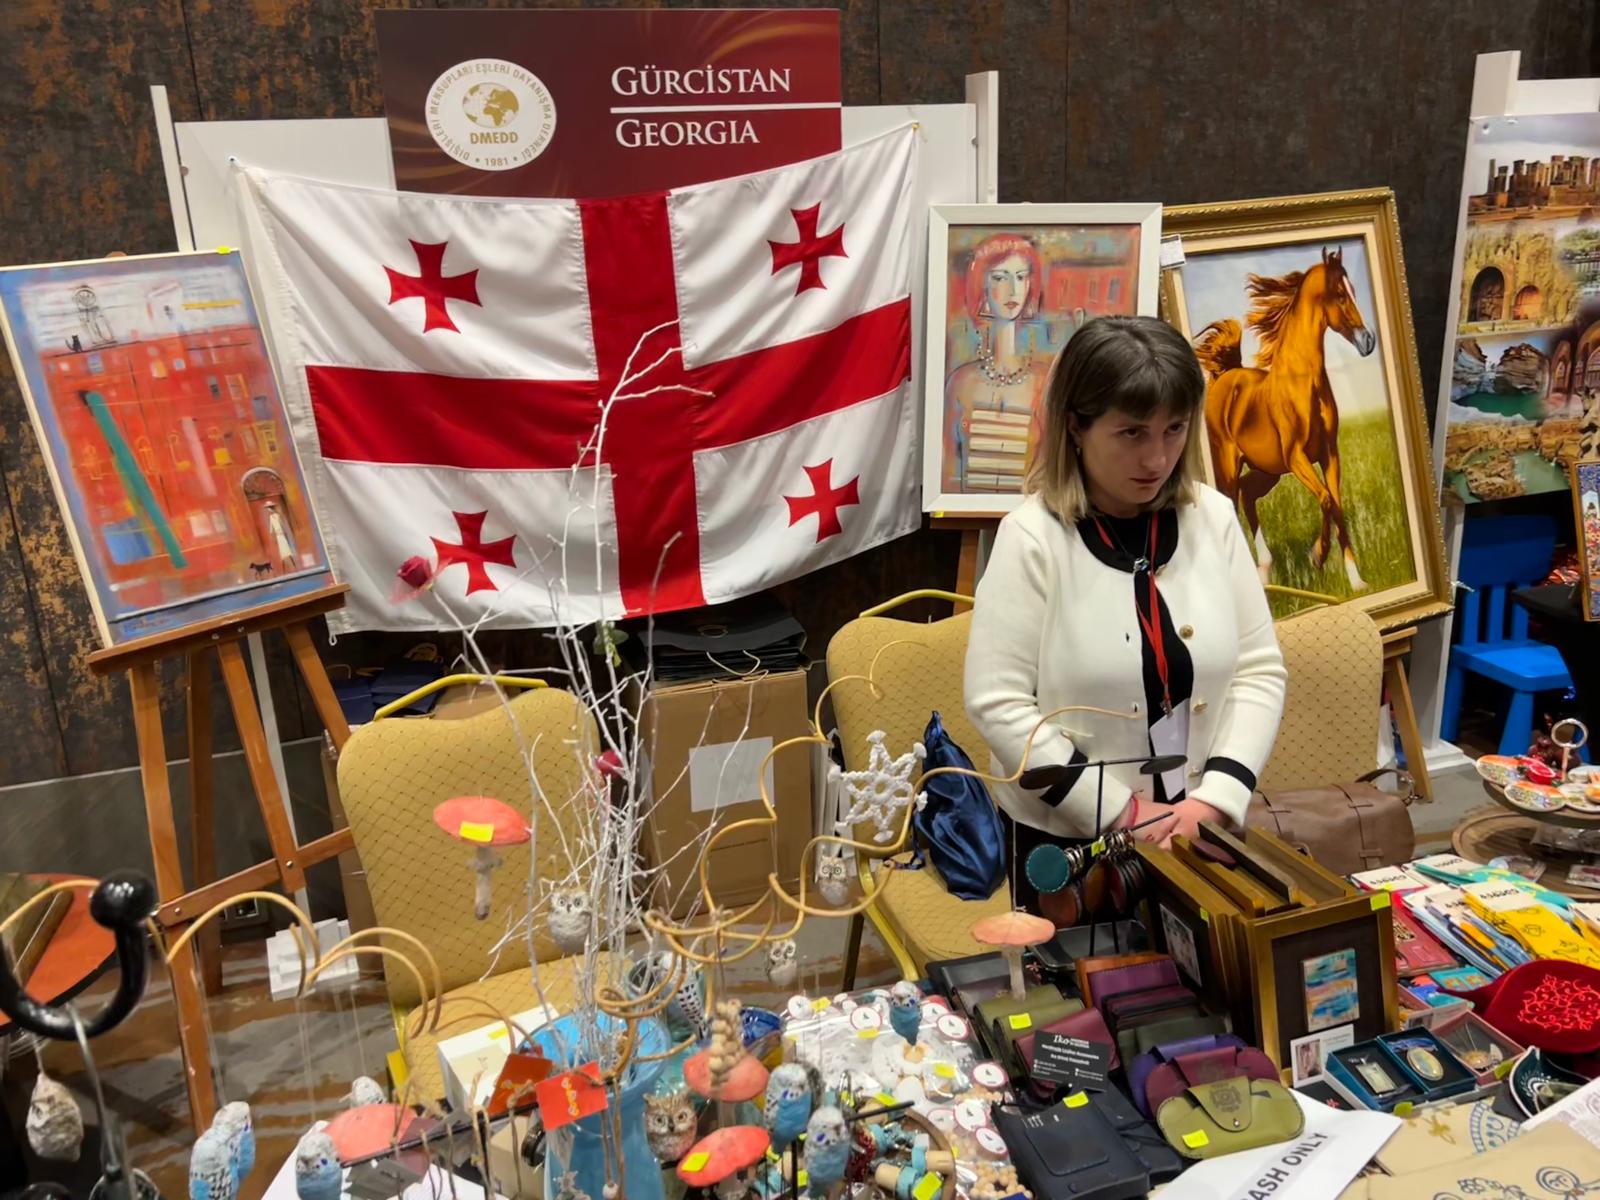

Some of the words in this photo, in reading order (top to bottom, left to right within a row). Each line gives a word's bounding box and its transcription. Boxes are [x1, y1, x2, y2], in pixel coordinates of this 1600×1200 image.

[475, 63, 511, 75] EŞLERİ
[611, 64, 791, 96] GÜRCİSTAN
[469, 131, 519, 145] DMEDD
[615, 118, 761, 148] GEORGIA
[484, 157, 509, 167] 1981
[1240, 1167, 1290, 1200] ASH
[1281, 1132, 1329, 1166] ONLY
